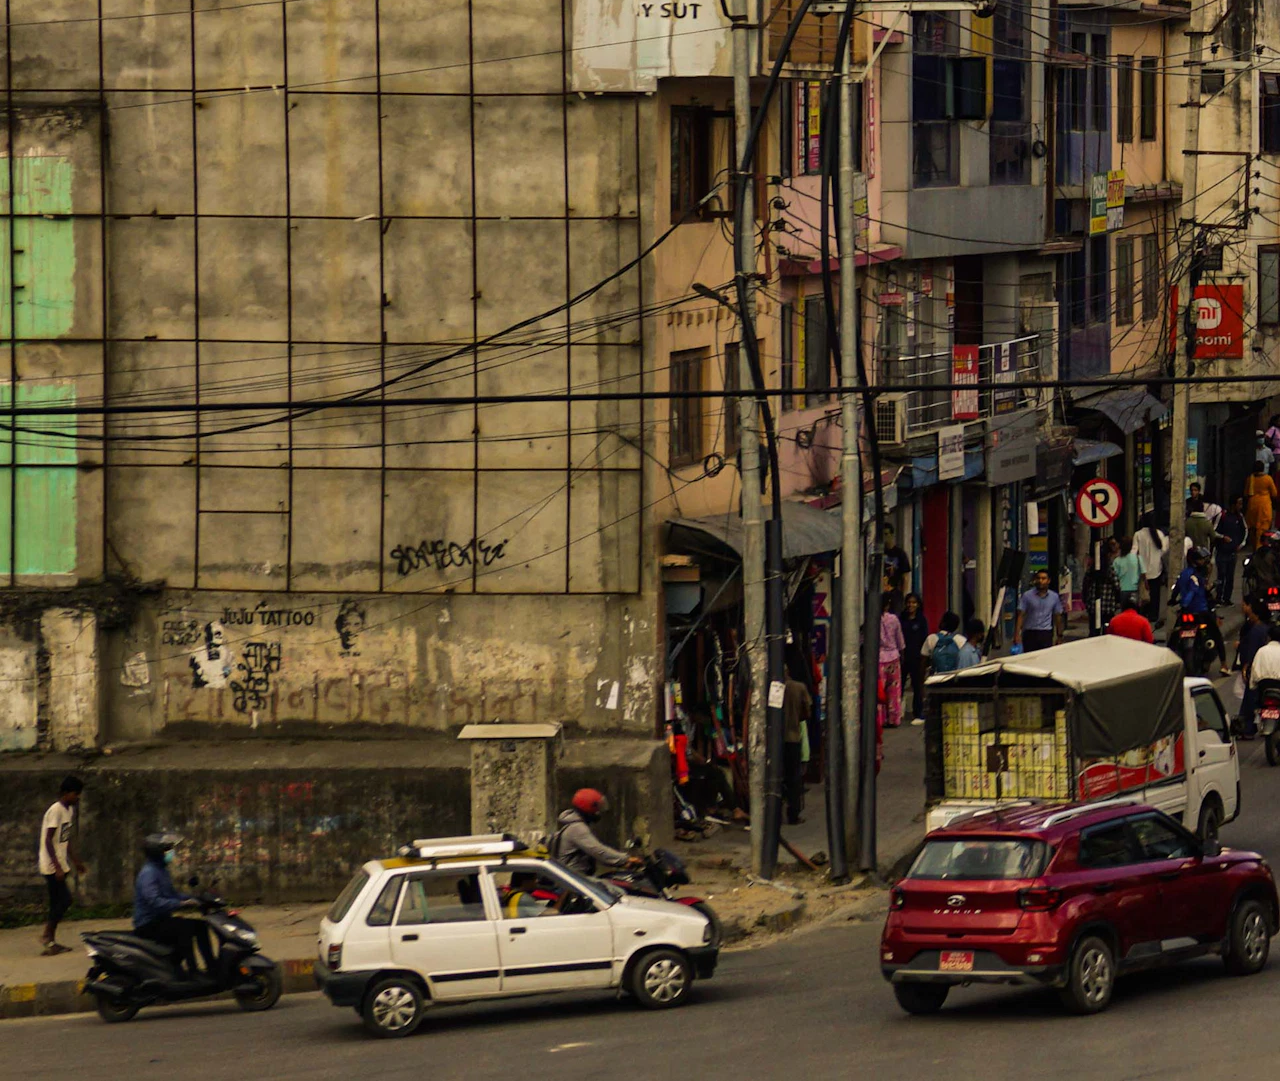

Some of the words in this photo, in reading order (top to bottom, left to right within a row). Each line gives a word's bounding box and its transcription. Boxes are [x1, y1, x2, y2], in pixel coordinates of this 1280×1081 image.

[637, 4, 653, 17] Y
[1196, 333, 1231, 345] aomi
[1090, 489, 1109, 519] P
[257, 608, 315, 627] TATTOO
